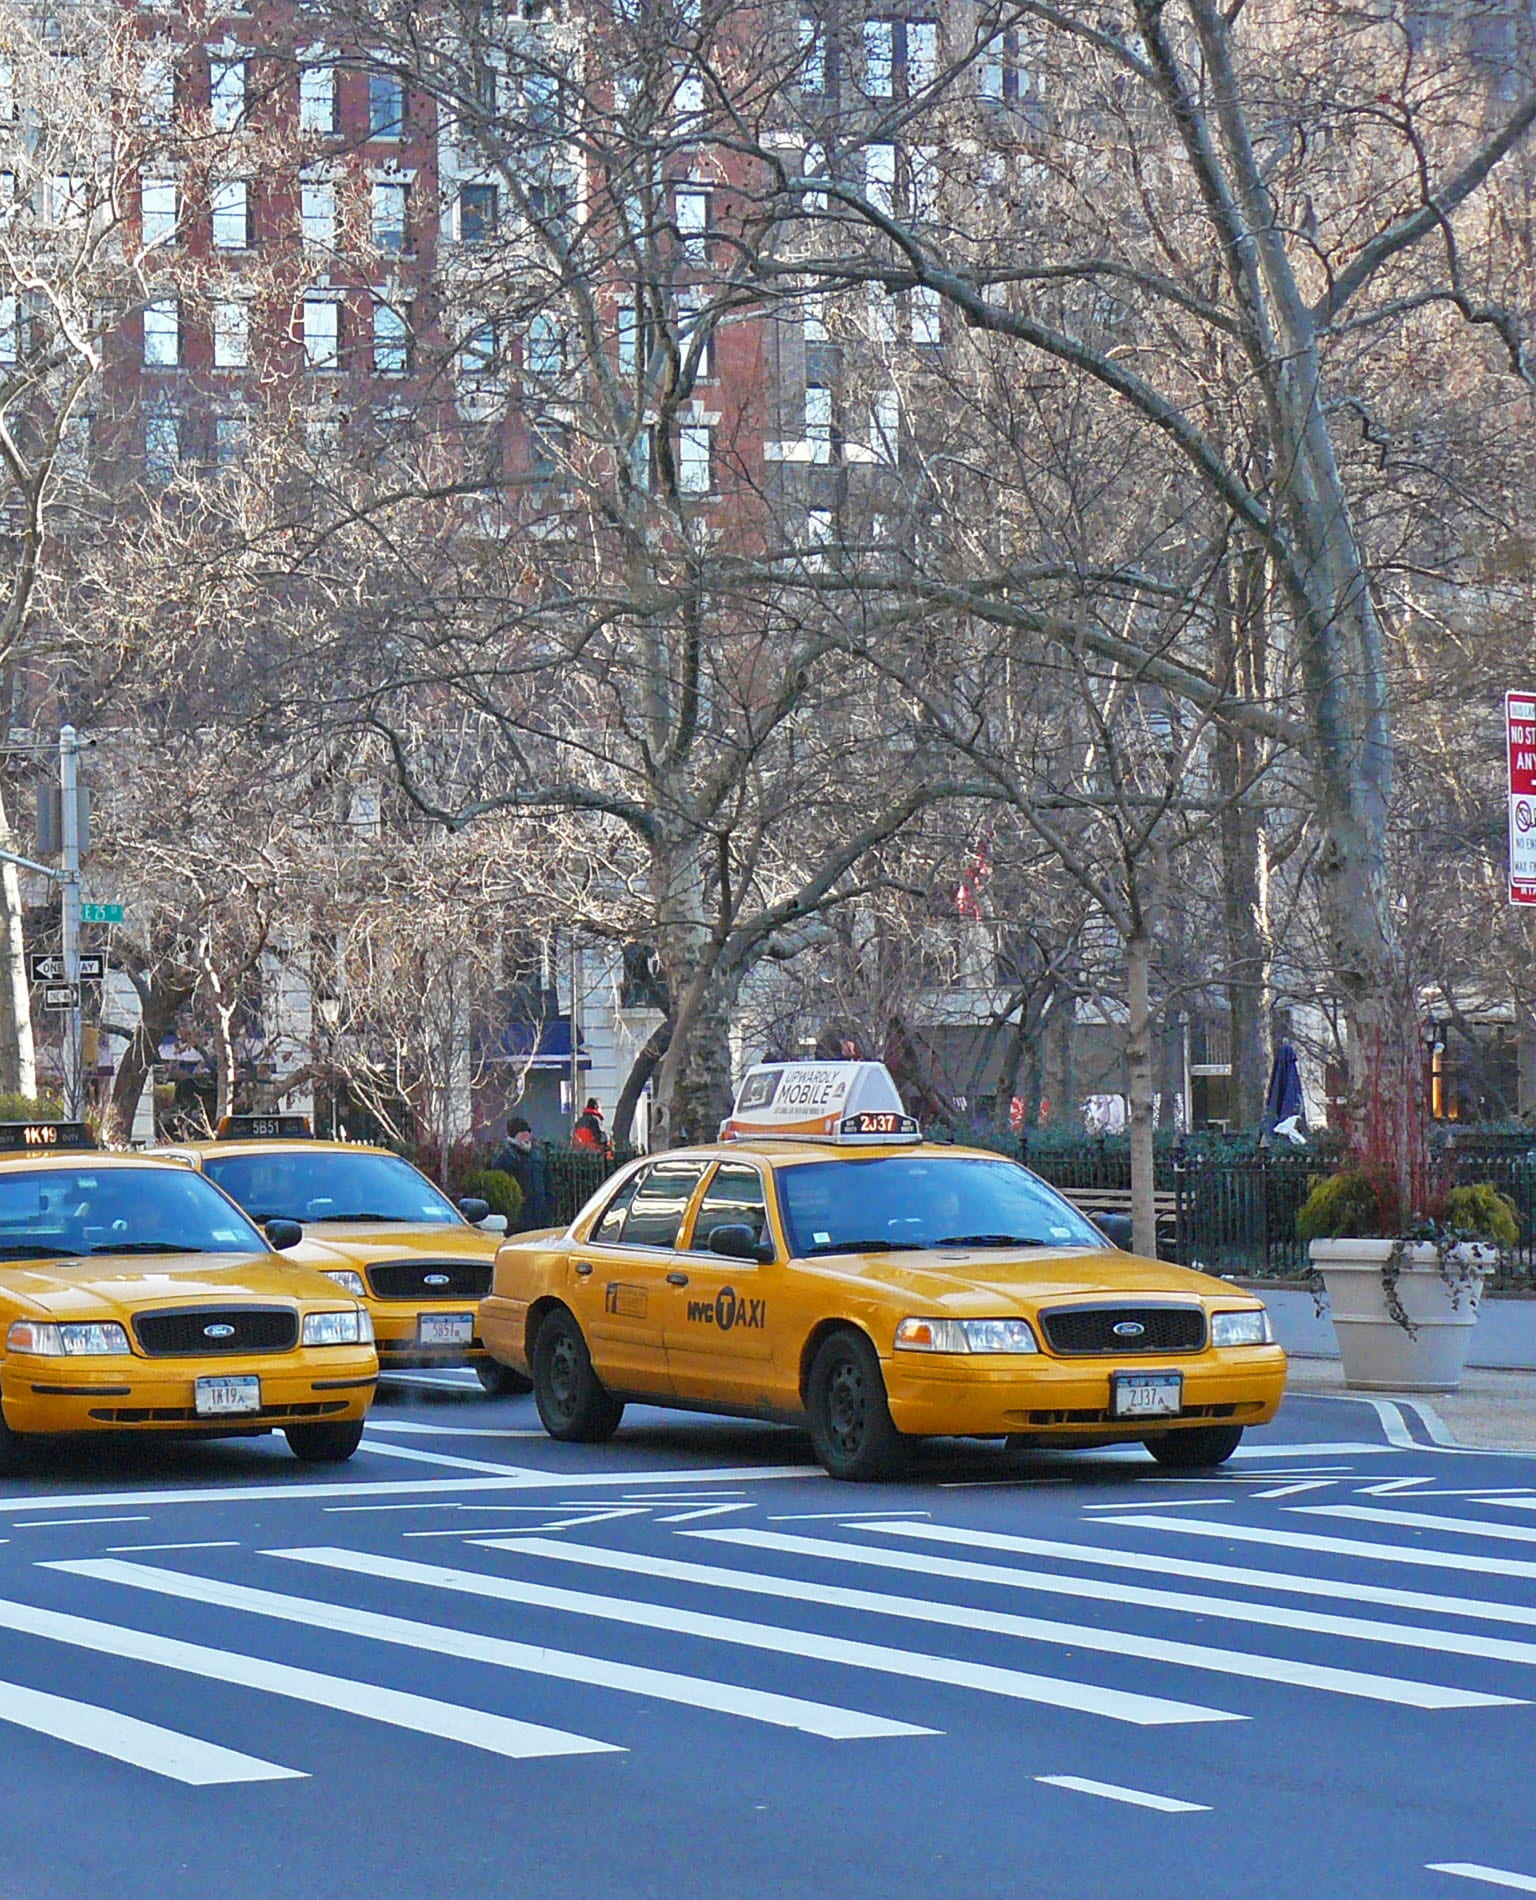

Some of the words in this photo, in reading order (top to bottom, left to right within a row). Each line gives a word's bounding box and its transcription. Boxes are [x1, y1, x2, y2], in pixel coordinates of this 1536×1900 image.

[1511, 725, 1524, 744] NO
[43, 962, 62, 974] ONE
[80, 962, 95, 972] AY
[785, 1070, 840, 1083] UPWARDLY
[777, 1084, 833, 1104] MOBILE
[252, 1120, 280, 1134] 5B51
[860, 1115, 894, 1131] 2J37
[24, 1126, 57, 1144] 1K19
[687, 1301, 713, 1323] NYC
[719, 1293, 766, 1329] TAXI
